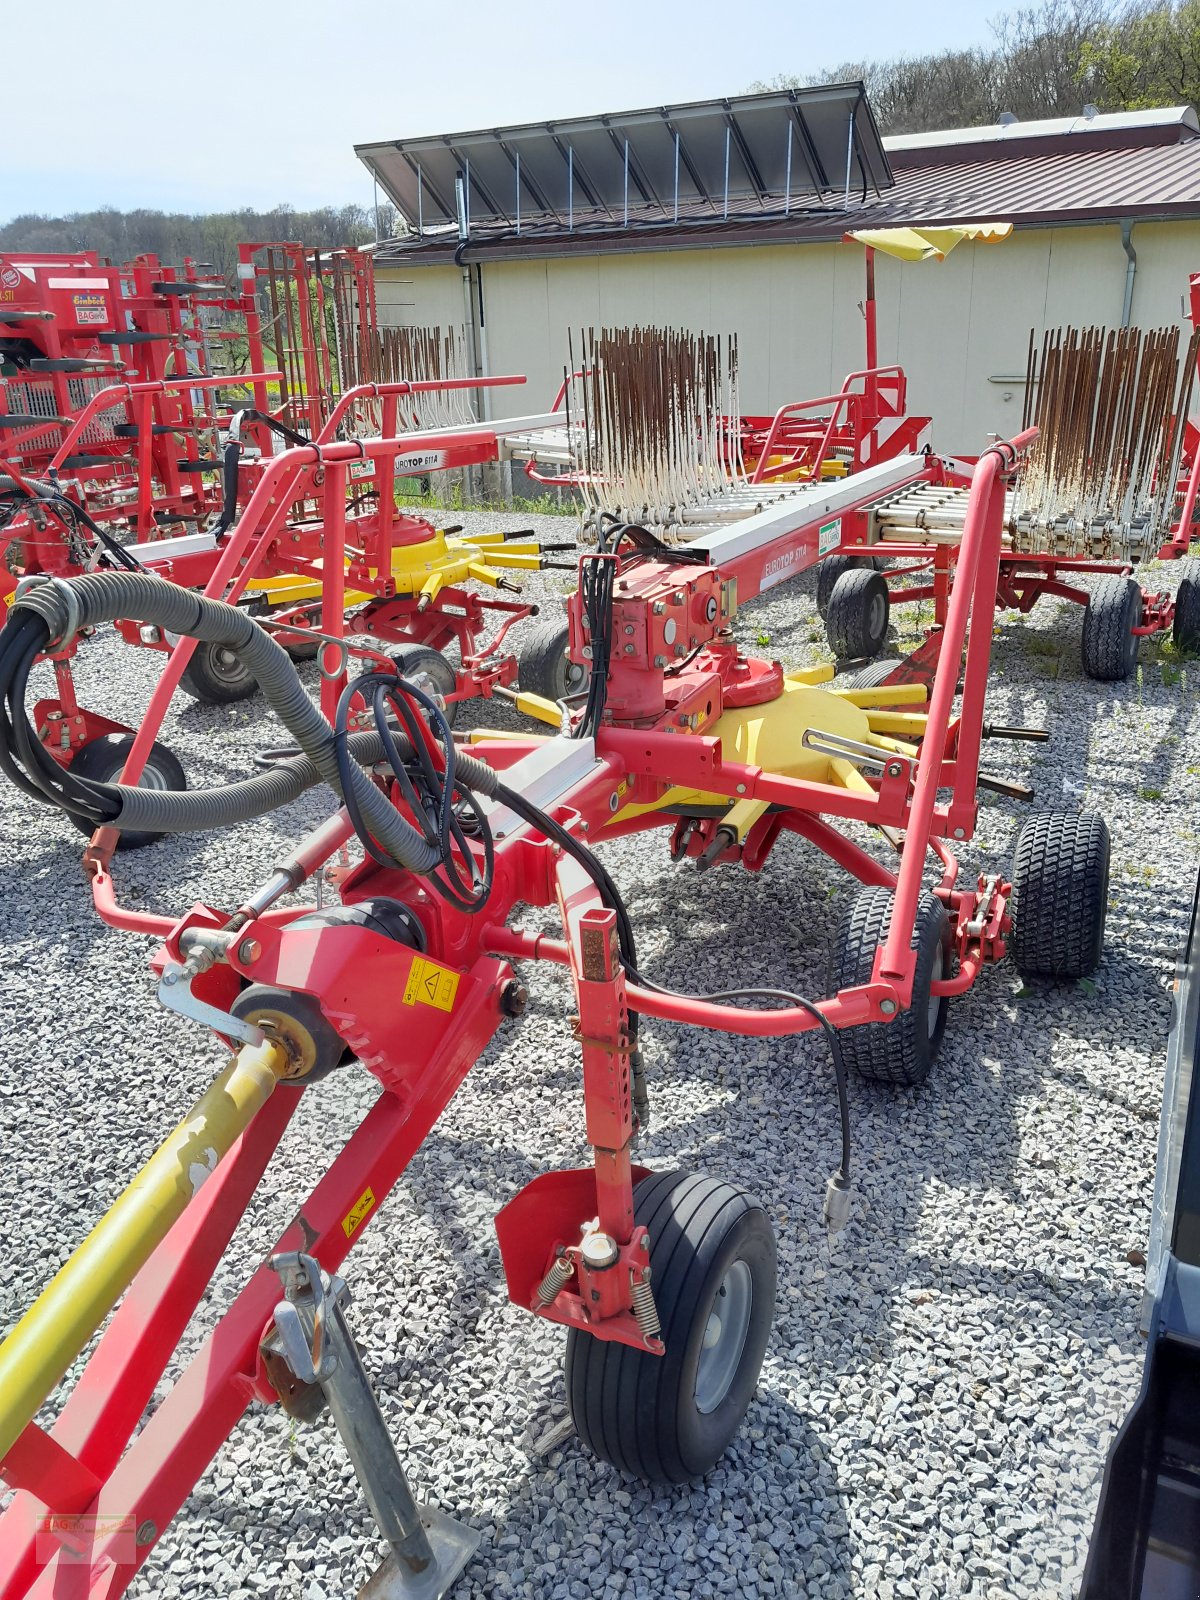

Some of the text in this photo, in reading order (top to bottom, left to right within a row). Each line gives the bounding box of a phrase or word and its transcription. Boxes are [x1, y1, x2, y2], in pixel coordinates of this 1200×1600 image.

[394, 454, 438, 470] UROTOP 611A
[765, 551, 794, 577] EUROTOP
